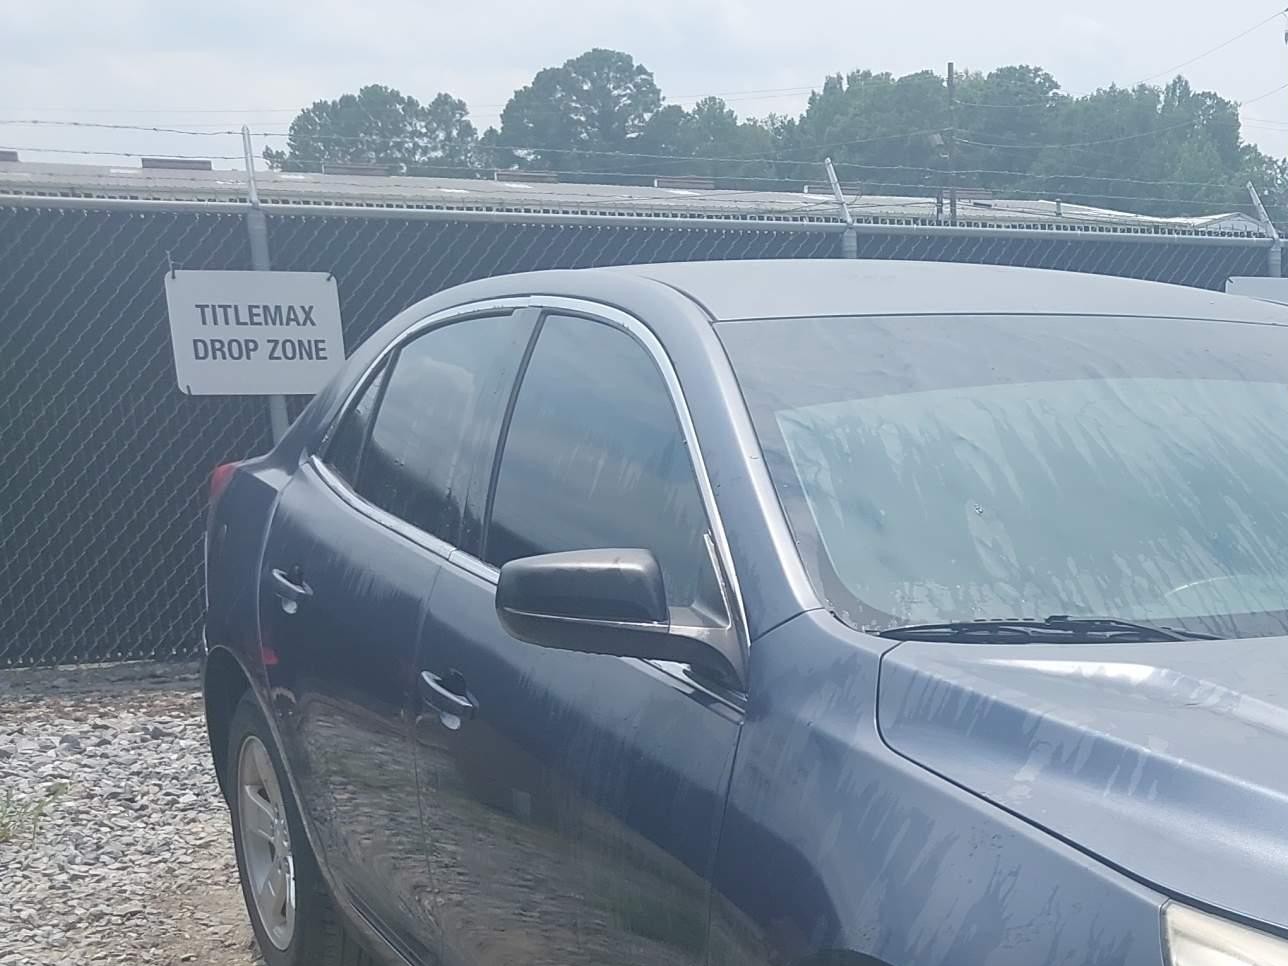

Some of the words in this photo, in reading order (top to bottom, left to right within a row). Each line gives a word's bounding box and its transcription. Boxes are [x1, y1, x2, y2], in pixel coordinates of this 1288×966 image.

[195, 304, 317, 327] TITLEMAX
[192, 339, 259, 361] DROP
[267, 339, 328, 361] ZONE
